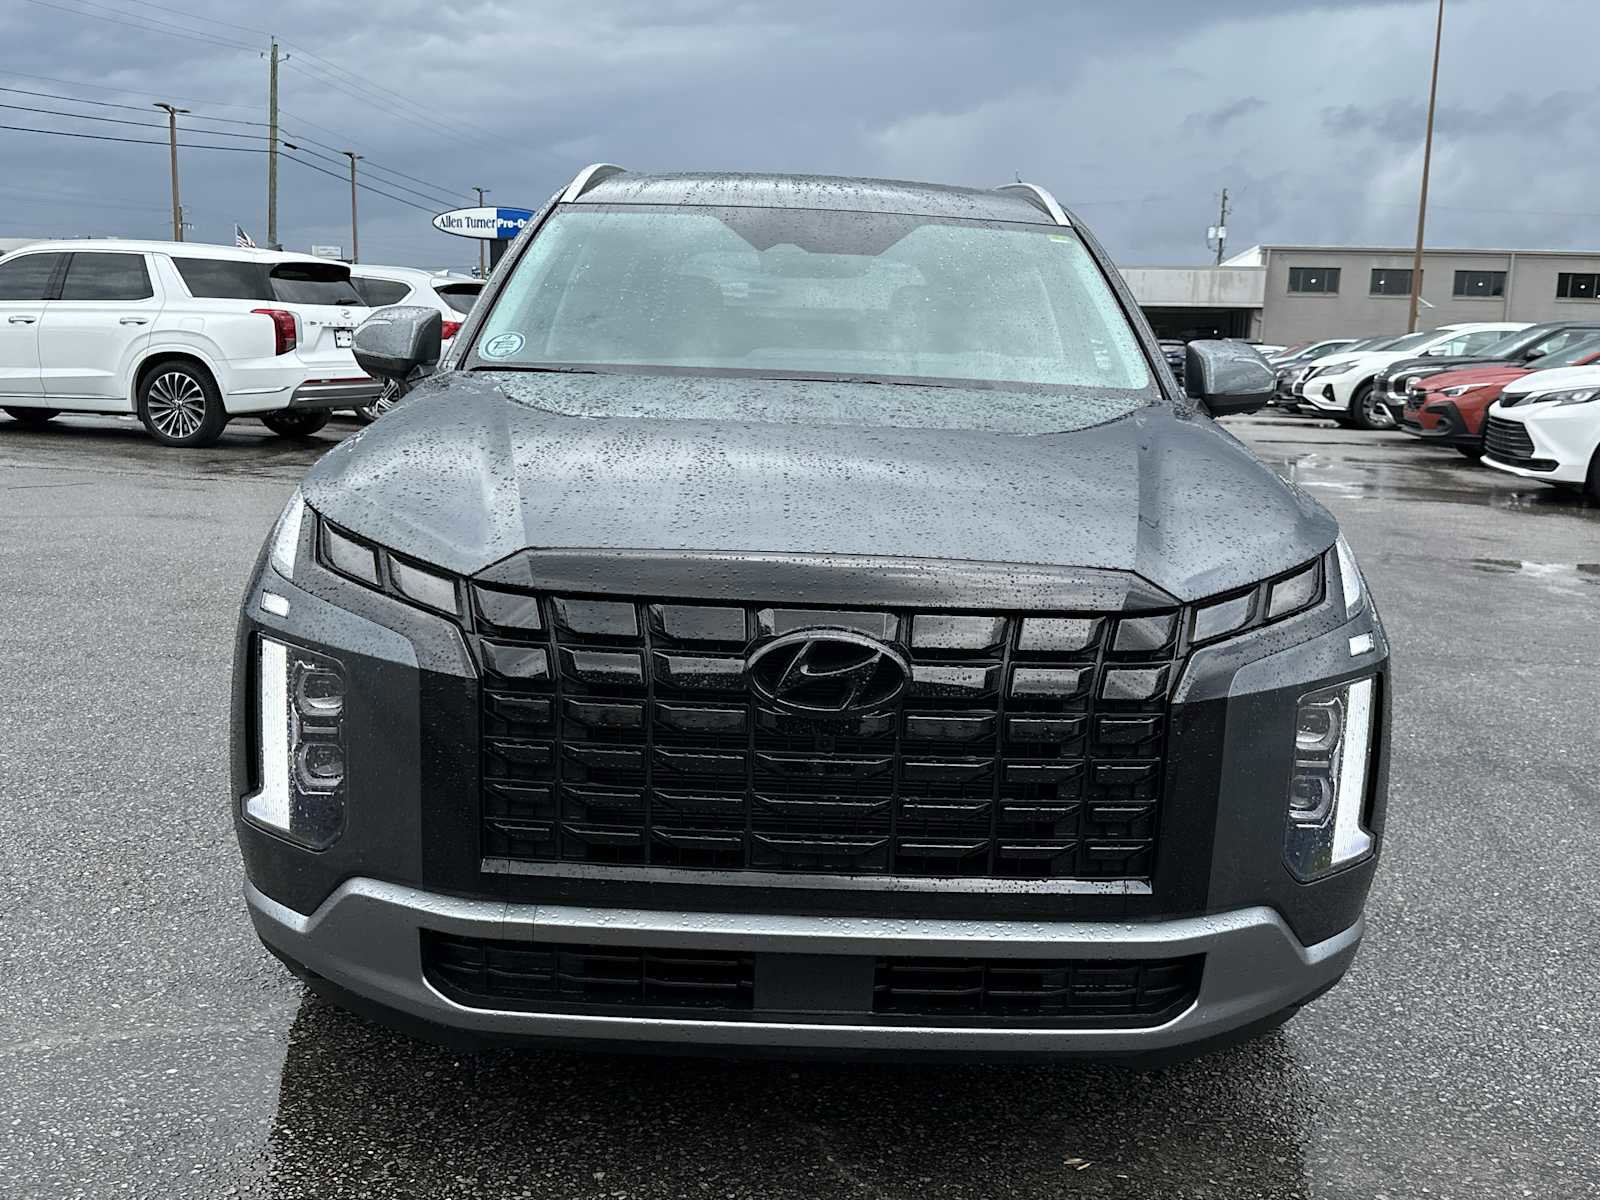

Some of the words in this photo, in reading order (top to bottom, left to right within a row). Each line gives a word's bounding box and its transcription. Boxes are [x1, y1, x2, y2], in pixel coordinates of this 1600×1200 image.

[440, 216, 463, 228] Allen
[465, 216, 496, 229] Turner
[497, 218, 527, 229] Pre-O
